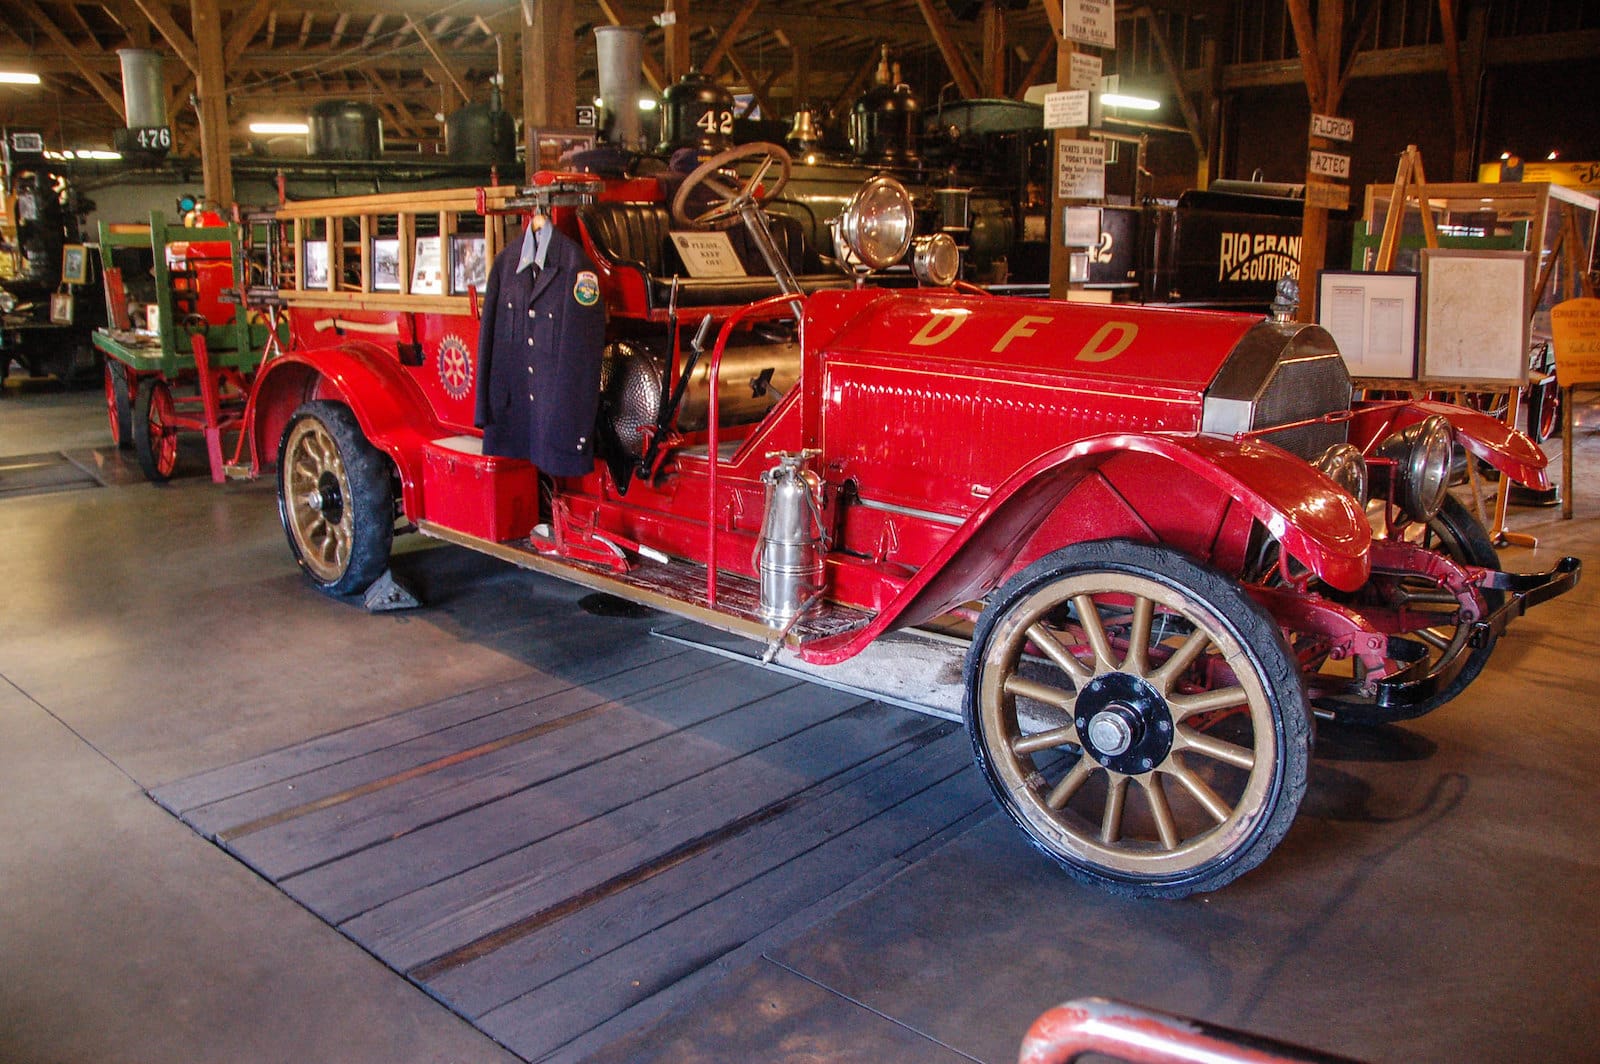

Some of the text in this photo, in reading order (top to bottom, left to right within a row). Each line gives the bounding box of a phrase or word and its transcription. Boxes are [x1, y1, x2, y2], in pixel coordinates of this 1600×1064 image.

[696, 110, 733, 135] 42
[1314, 117, 1352, 136] FLORIDA
[137, 128, 170, 148] 476
[1315, 155, 1346, 173] AZTEC
[1219, 232, 1302, 282] RIO GRAN
